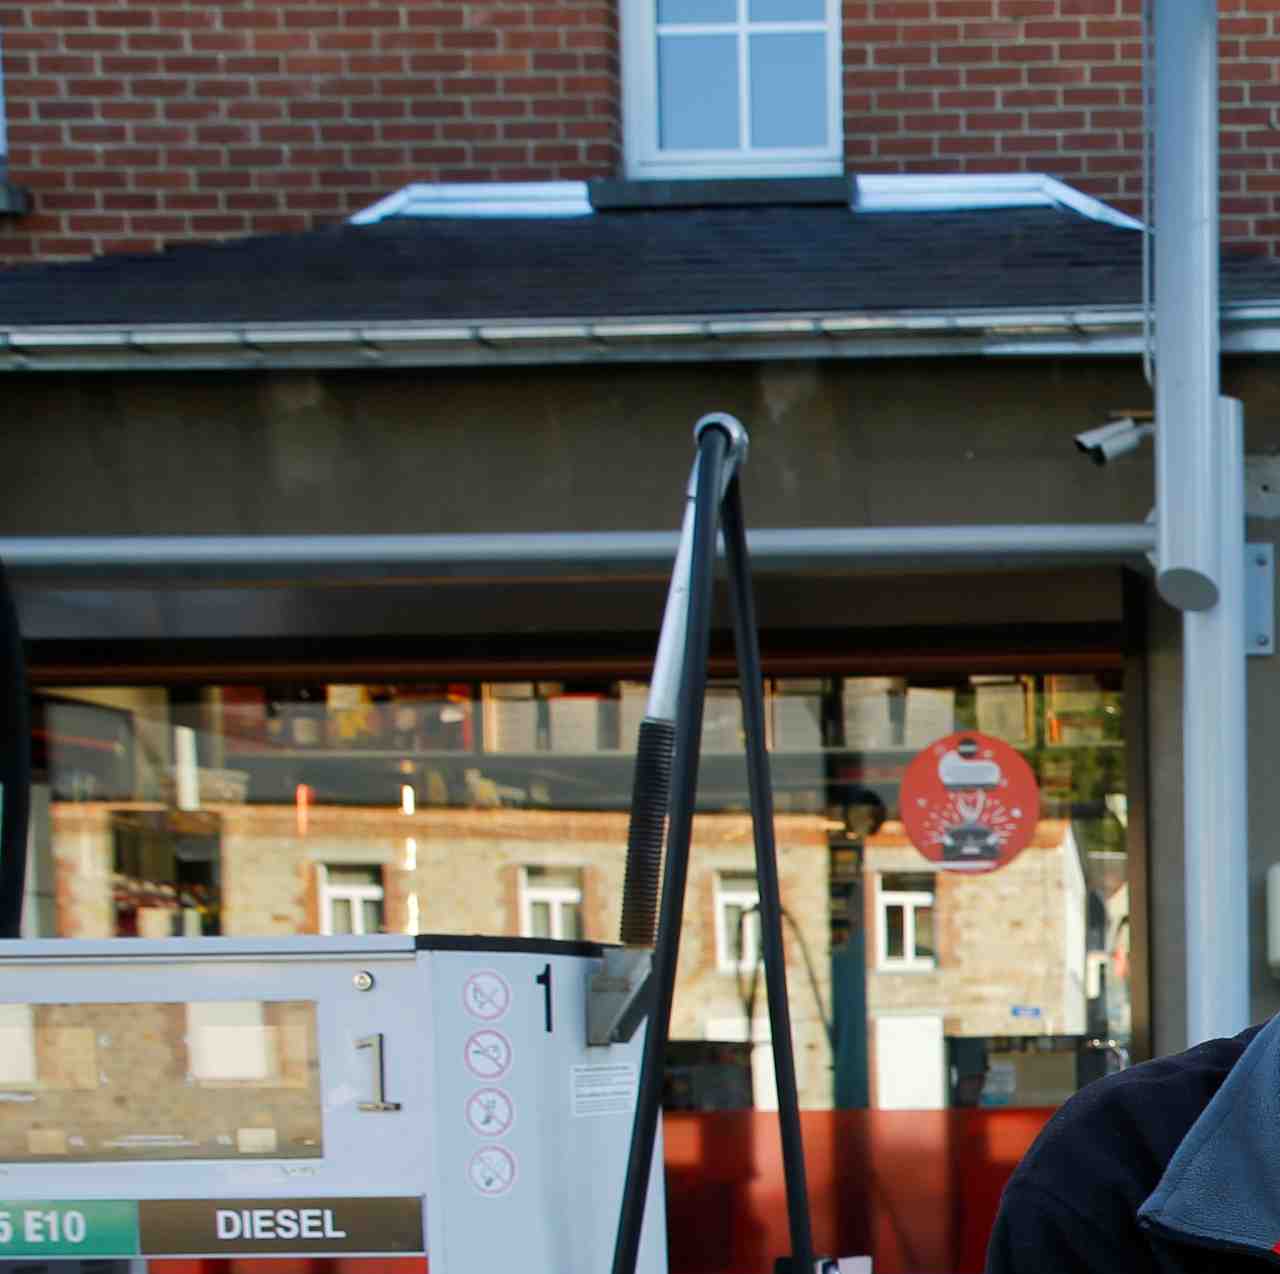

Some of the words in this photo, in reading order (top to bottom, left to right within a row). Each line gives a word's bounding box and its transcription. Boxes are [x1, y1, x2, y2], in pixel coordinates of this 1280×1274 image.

[536, 963, 552, 1033] 1
[355, 1032, 402, 1111] 1
[24, 1209, 87, 1243] E10
[215, 1208, 347, 1240] DIESEL
